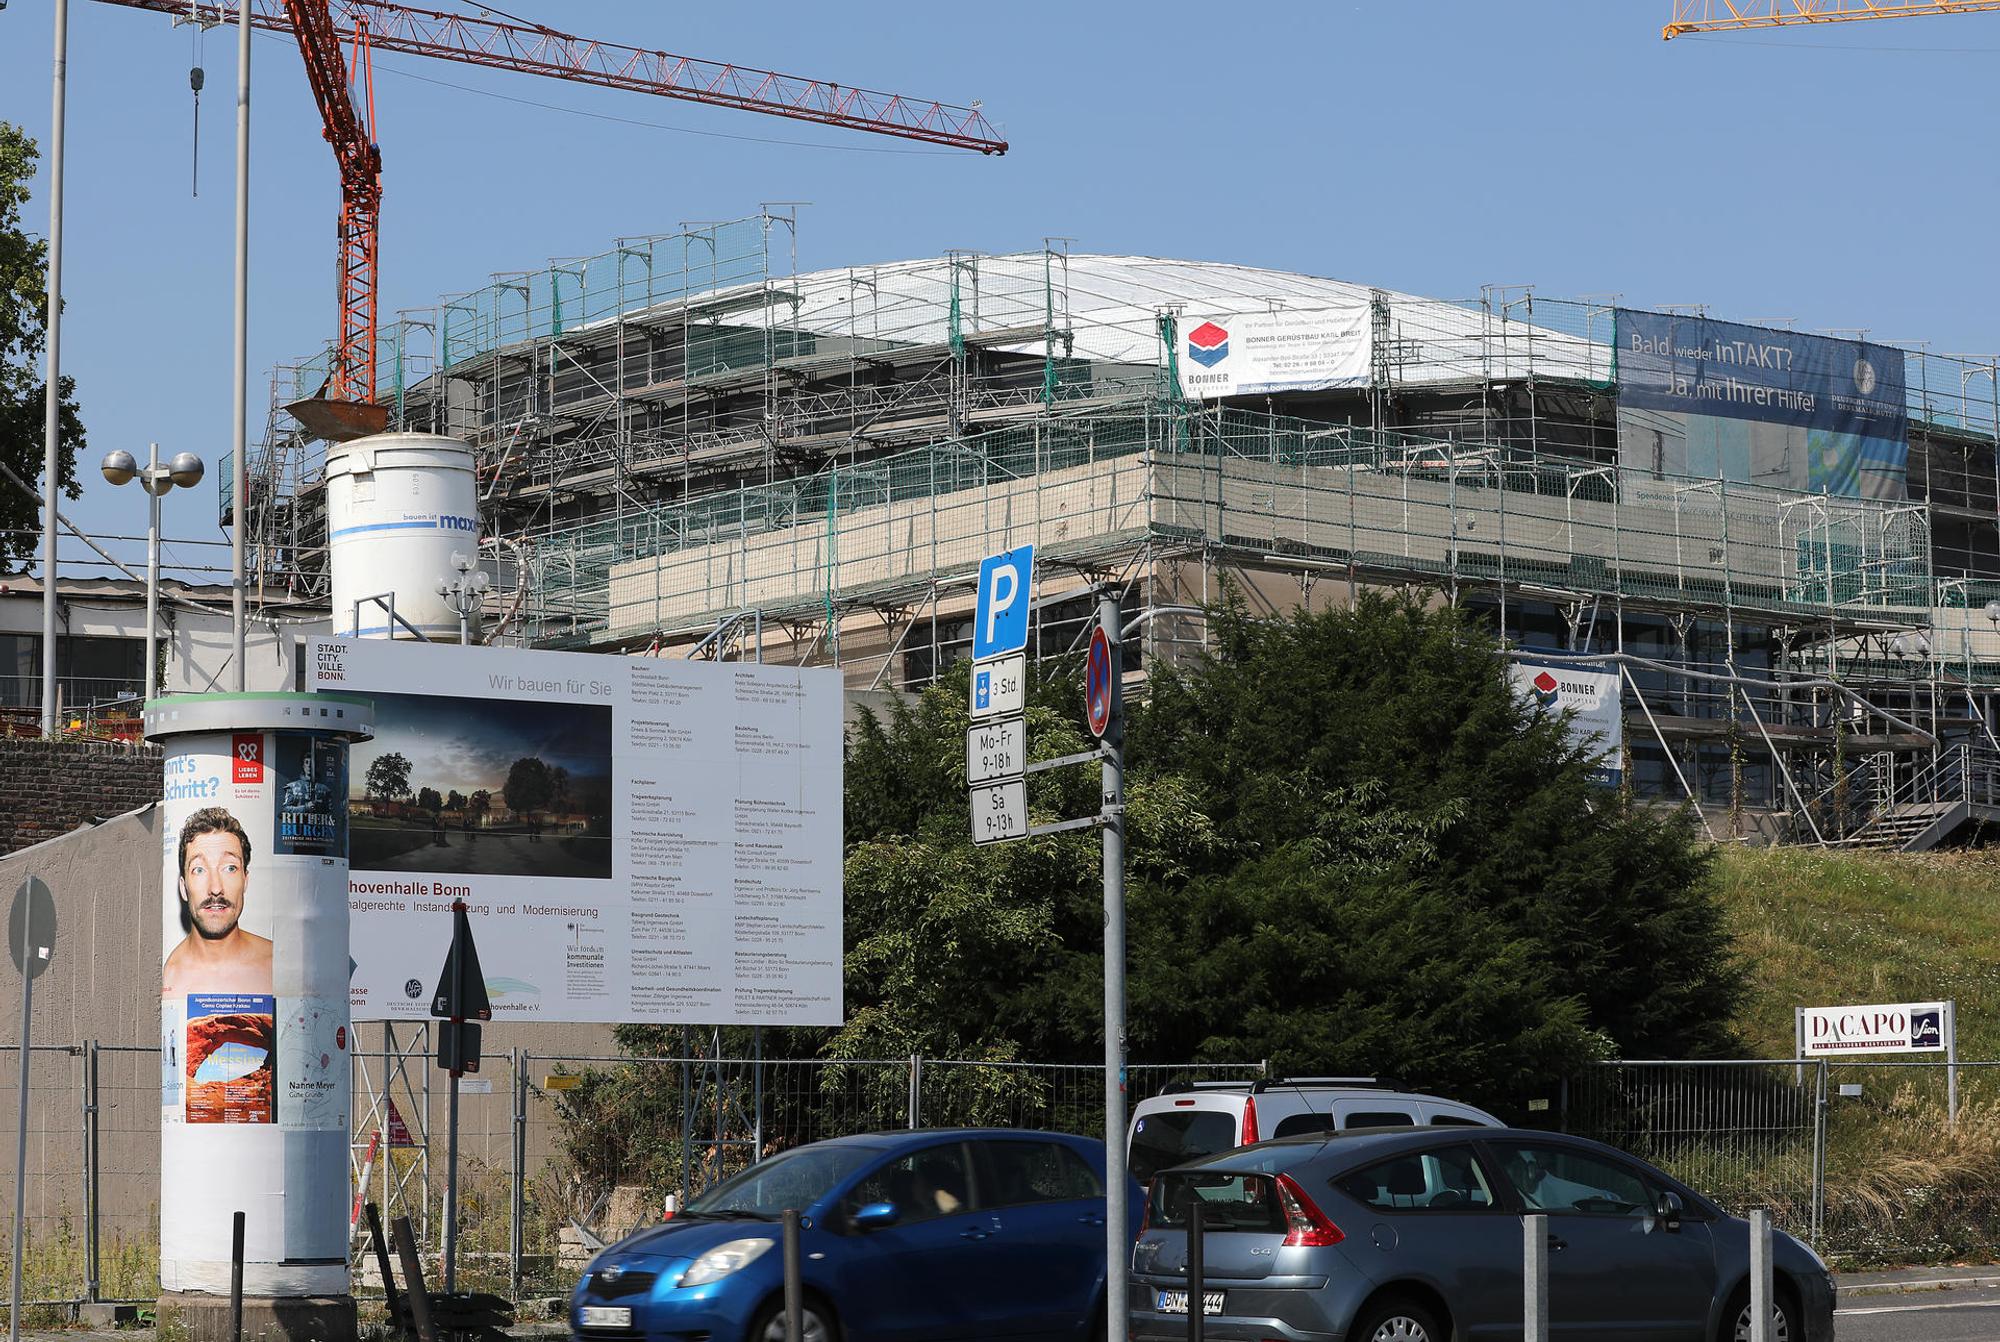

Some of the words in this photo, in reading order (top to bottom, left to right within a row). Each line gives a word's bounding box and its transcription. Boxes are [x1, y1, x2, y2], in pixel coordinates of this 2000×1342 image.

[1277, 333, 1319, 341] GERÜSTBAU
[1632, 334, 1669, 356] Bald
[1674, 347, 1712, 361] wieder
[1716, 340, 1792, 372] inTAKT?
[1189, 374, 1228, 384] BONNER
[1666, 371, 1692, 398] Ja,
[1696, 384, 1722, 401] mit
[1726, 377, 1774, 407] Ihrer
[1778, 390, 1815, 412] Hilfe!
[986, 563, 1019, 644] P
[317, 644, 348, 654] STADT.
[317, 653, 340, 662] CITY.
[317, 662, 345, 672] VILLE.
[317, 671, 346, 681] BONN.
[488, 674, 514, 690] Wir
[518, 676, 562, 693] bauen
[567, 679, 585, 694] für
[590, 681, 612, 696] Sie
[992, 682, 998, 696] 3
[1001, 676, 1019, 695] Std.
[1561, 683, 1595, 695] BONNER
[980, 731, 1012, 750] Mo-Fr
[982, 754, 1011, 772] 9-18h
[165, 777, 220, 801] Schritt?
[992, 793, 1005, 810] Sa
[986, 816, 1014, 833] 9-13h
[349, 881, 428, 896] hovenhalle
[433, 883, 470, 896] Bonn
[414, 902, 489, 916] Instandzung
[497, 906, 516, 914] und
[523, 905, 598, 919] Modernisierung
[289, 1081, 315, 1089] Nanne
[316, 1081, 335, 1091] Meyer
[1165, 1291, 1179, 1307] BN
